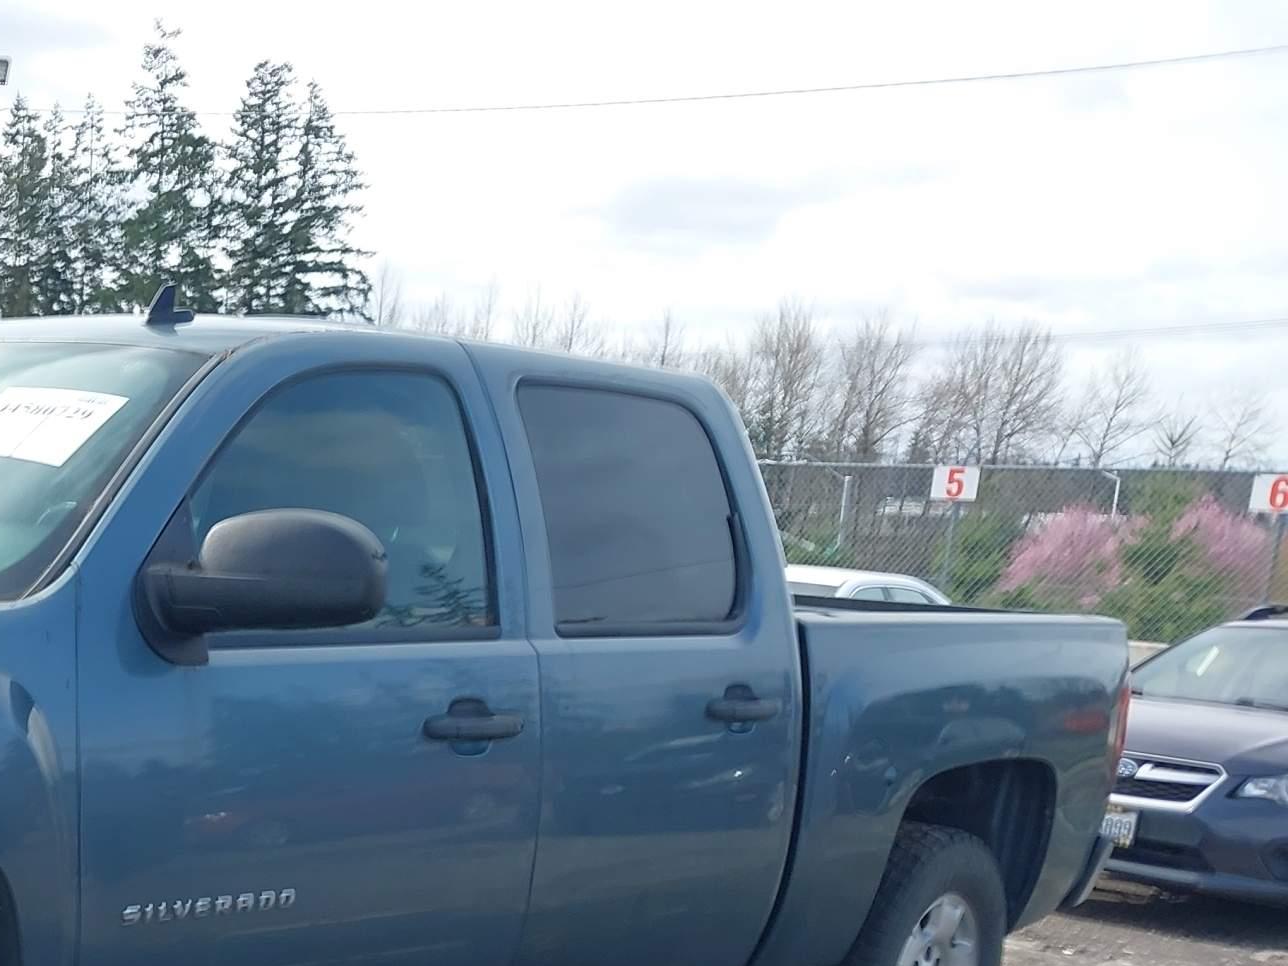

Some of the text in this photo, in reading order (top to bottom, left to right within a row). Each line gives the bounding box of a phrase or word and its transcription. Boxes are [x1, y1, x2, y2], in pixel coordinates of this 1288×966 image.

[945, 467, 966, 498] 5
[1269, 474, 1288, 511] 6
[120, 887, 297, 927] SILVERADO
